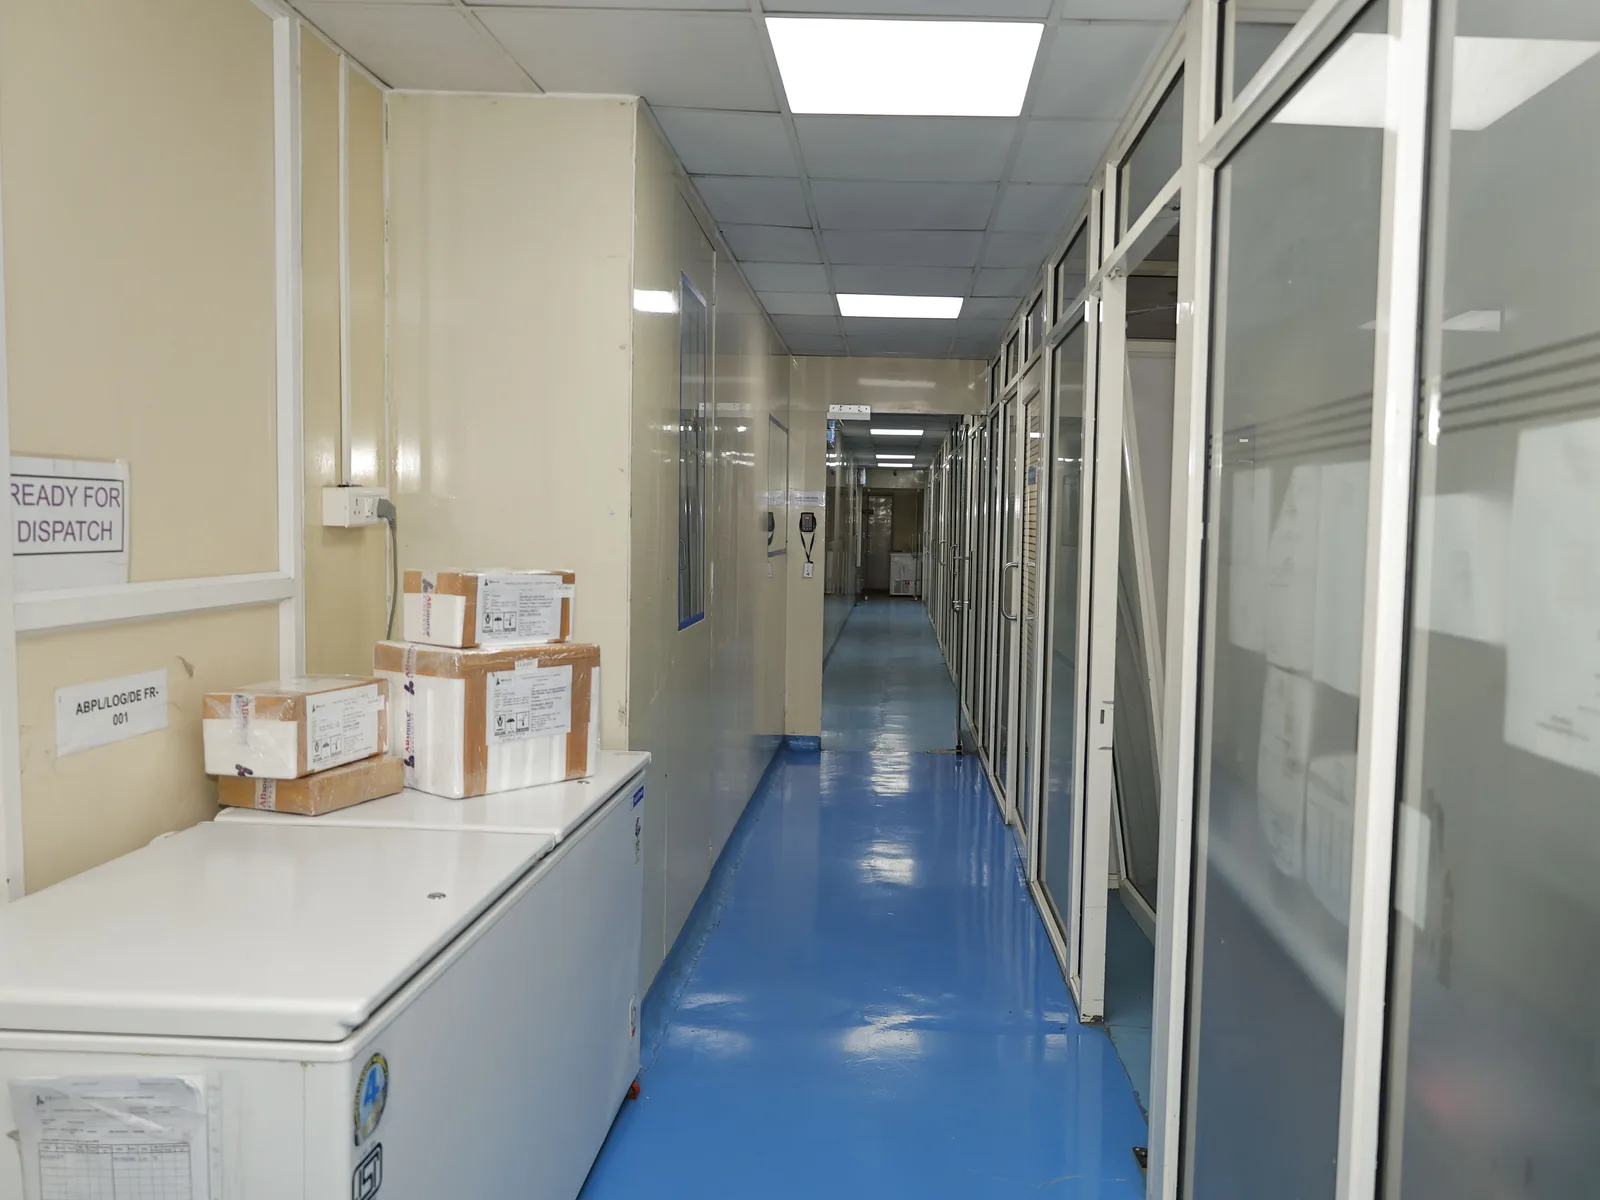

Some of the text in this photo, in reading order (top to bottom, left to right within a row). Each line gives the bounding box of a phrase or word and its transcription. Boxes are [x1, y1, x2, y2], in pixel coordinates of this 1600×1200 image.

[11, 483, 121, 508] READY FOR
[17, 520, 113, 543] DISPATCH
[76, 689, 142, 715] ABPL/LOG/DE
[113, 711, 129, 726] 001
